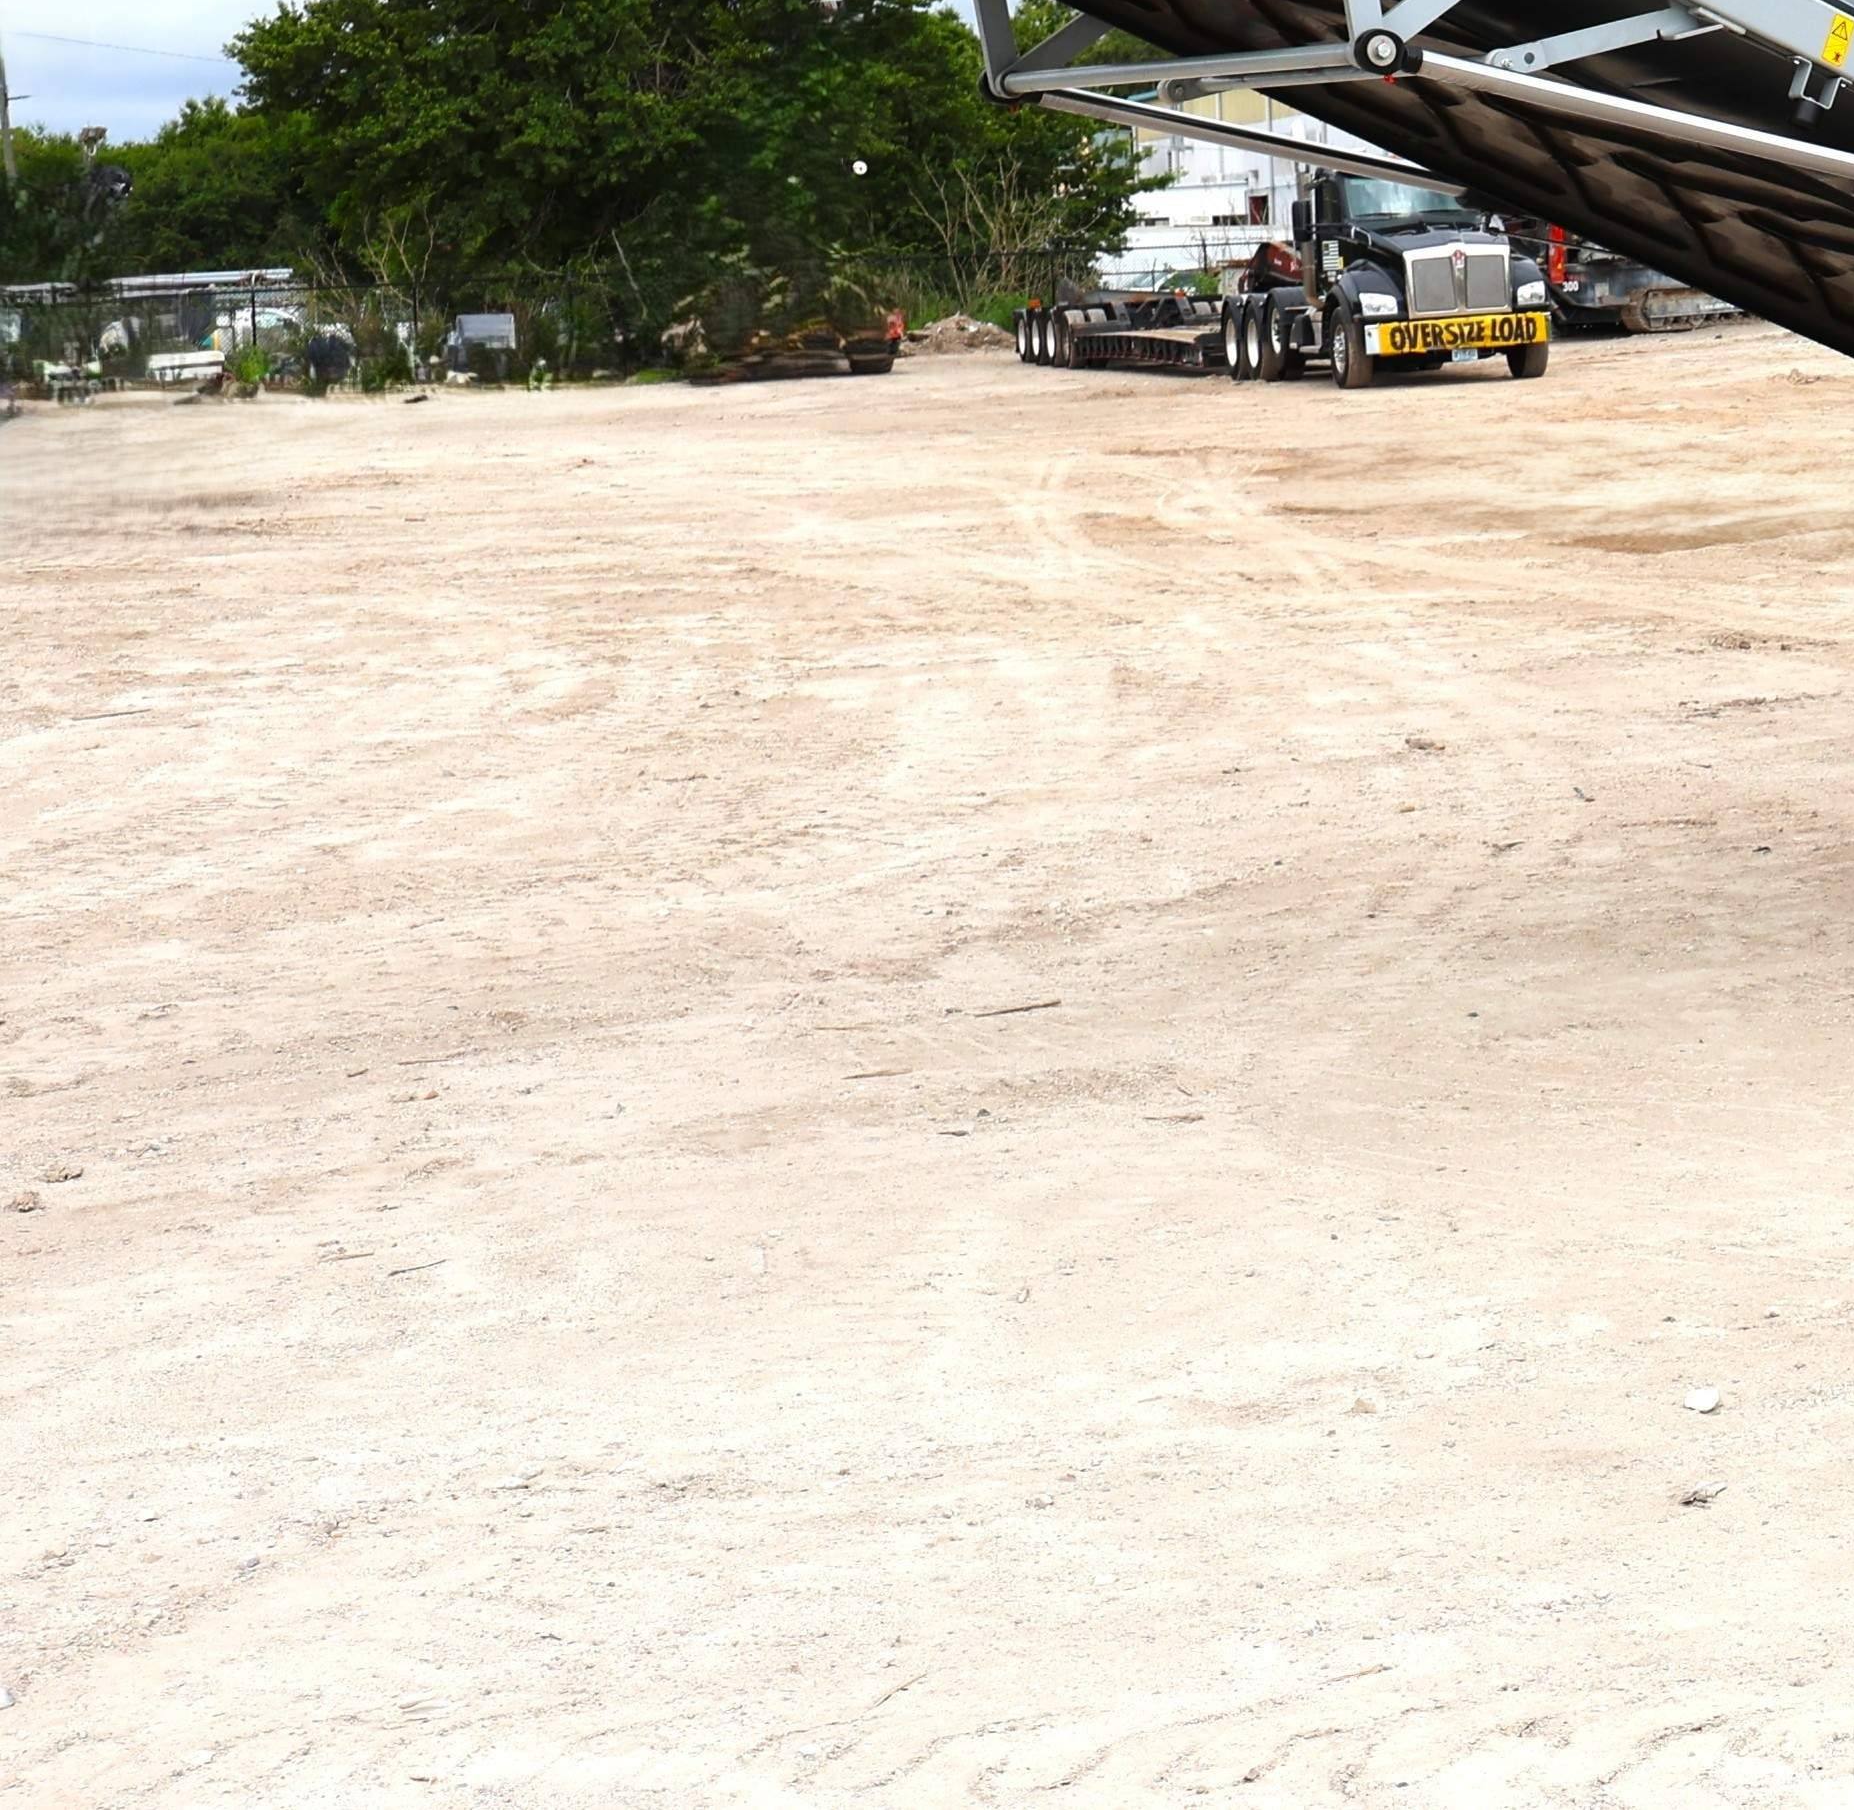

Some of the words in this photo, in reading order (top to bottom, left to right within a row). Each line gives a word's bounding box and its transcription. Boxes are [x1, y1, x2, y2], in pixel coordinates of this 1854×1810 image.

[1562, 280, 1580, 293] 300
[1389, 321, 1486, 351] OVERSIZE
[1491, 316, 1538, 343] LOAD
